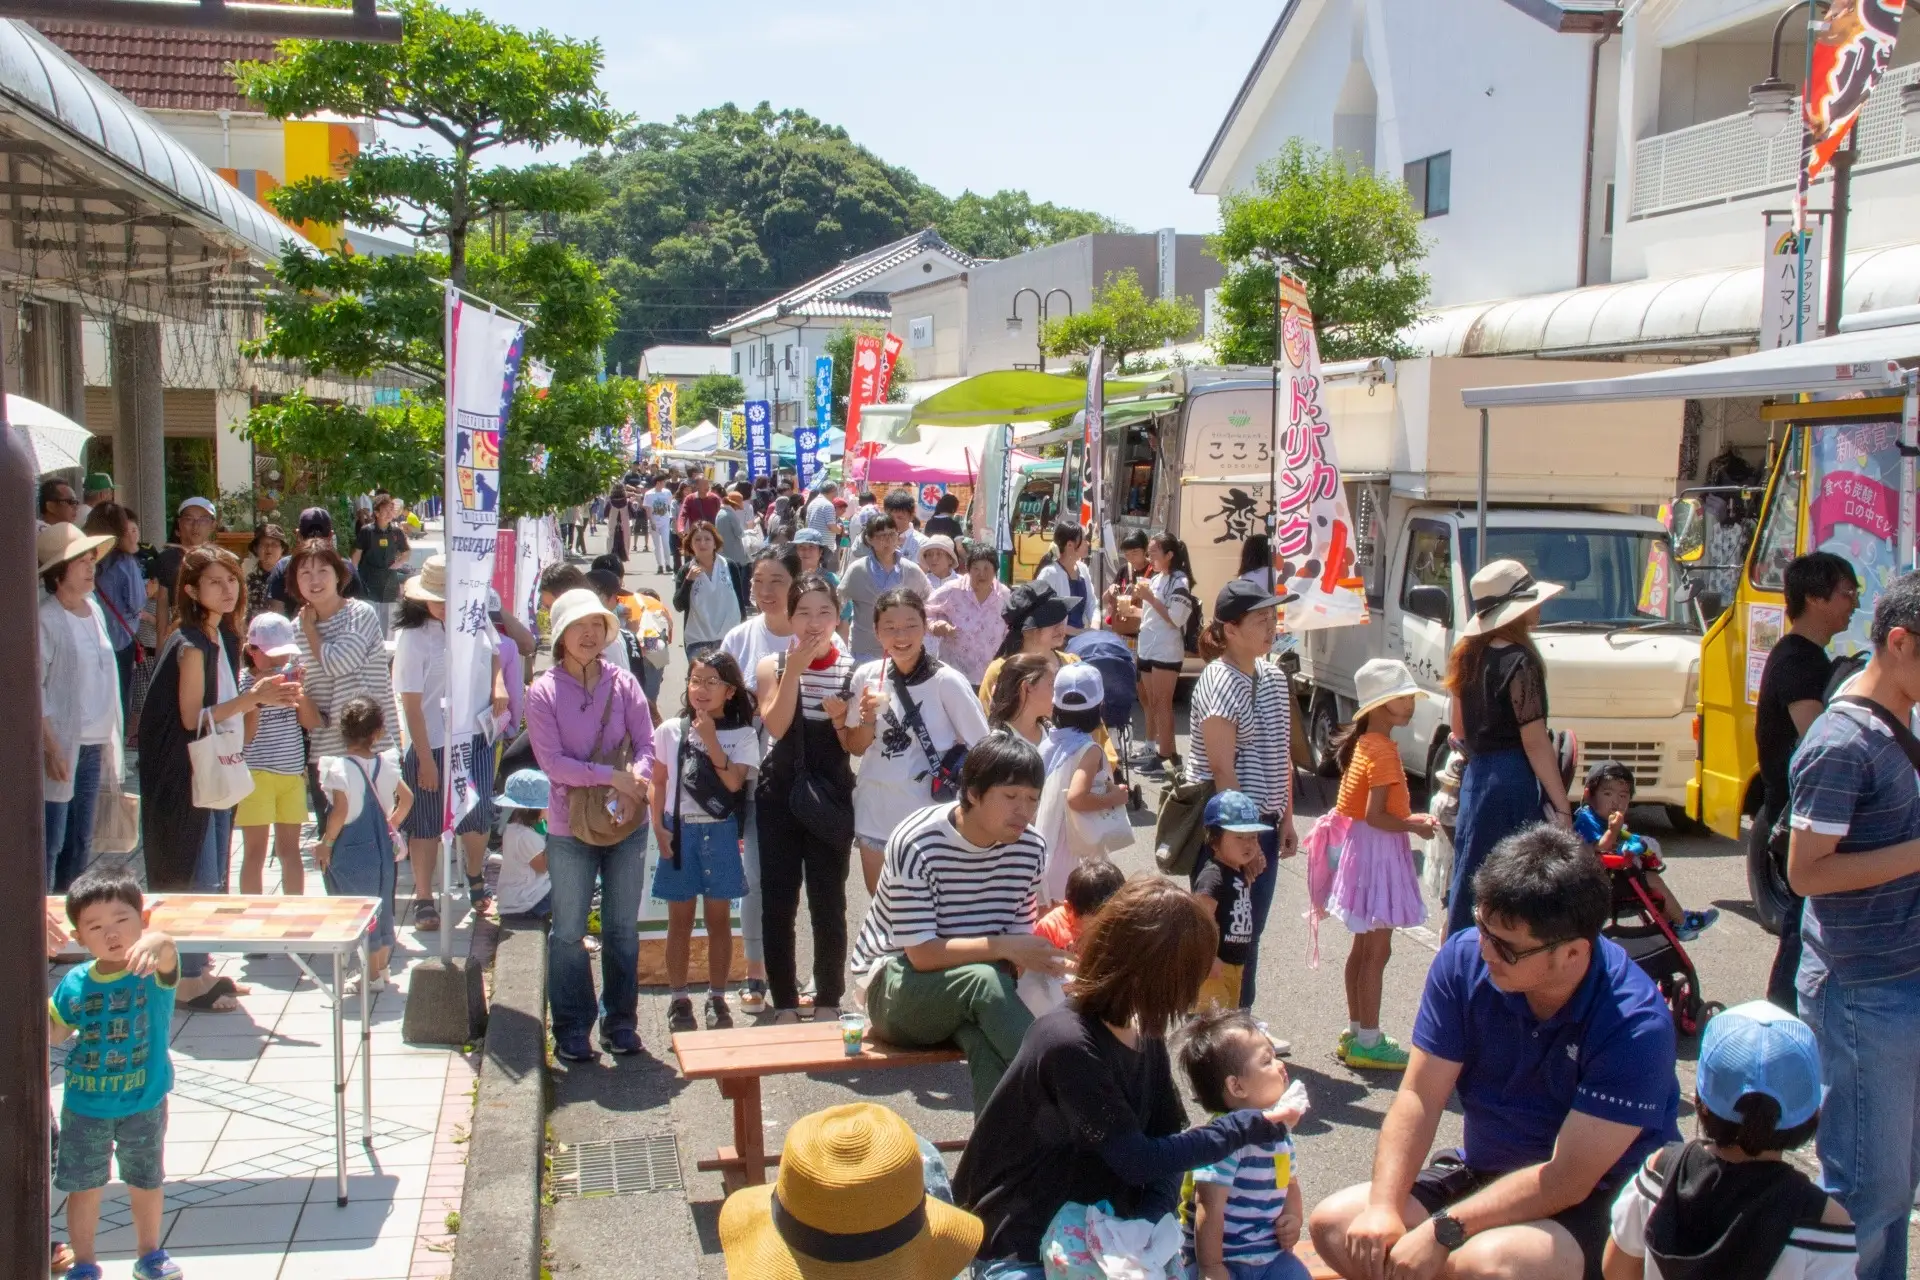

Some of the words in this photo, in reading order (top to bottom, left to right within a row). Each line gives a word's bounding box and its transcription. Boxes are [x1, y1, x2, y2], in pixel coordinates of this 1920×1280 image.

[1208, 442, 1269, 461] こころ
[1279, 376, 1315, 558] ドリンク
[921, 486, 944, 506] 氷
[1591, 1091, 1632, 1107] NORTH
